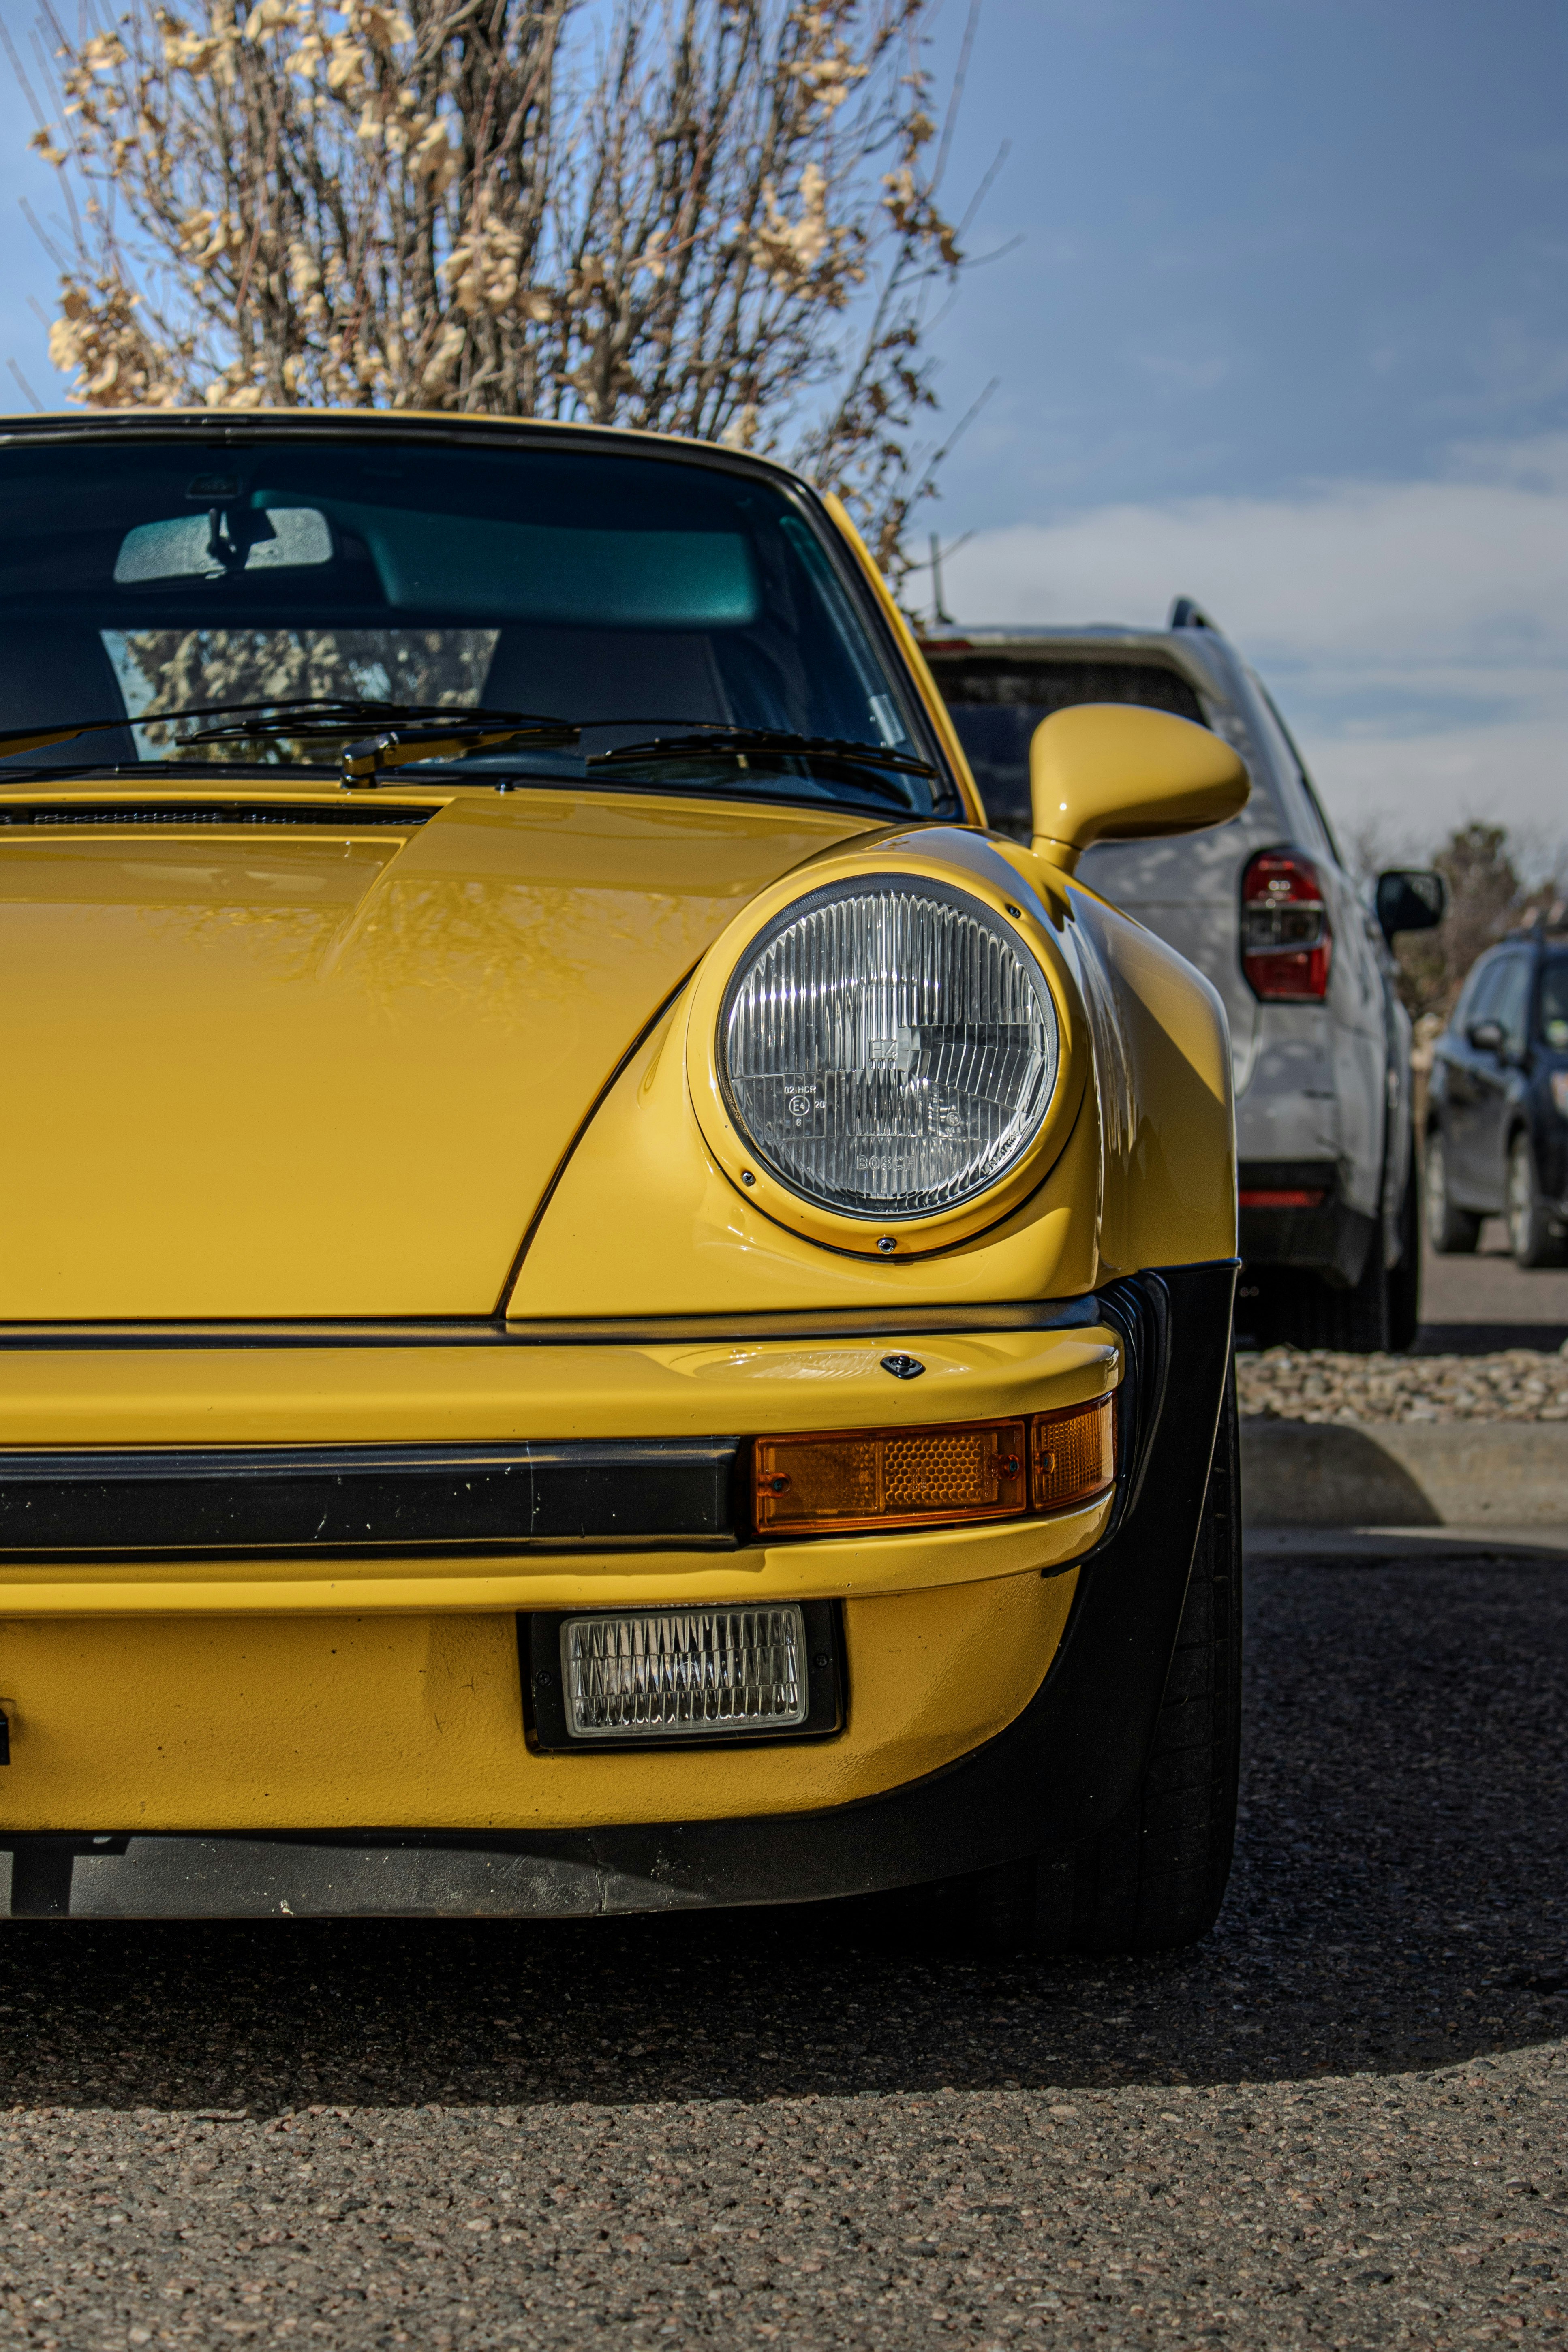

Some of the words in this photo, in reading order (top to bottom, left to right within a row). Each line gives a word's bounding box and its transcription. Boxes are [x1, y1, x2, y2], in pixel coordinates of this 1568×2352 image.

[869, 1040, 898, 1060] H4
[784, 1086, 794, 1094] 02
[815, 1100, 825, 1108] 20
[856, 1155, 916, 1171] BOSCH
